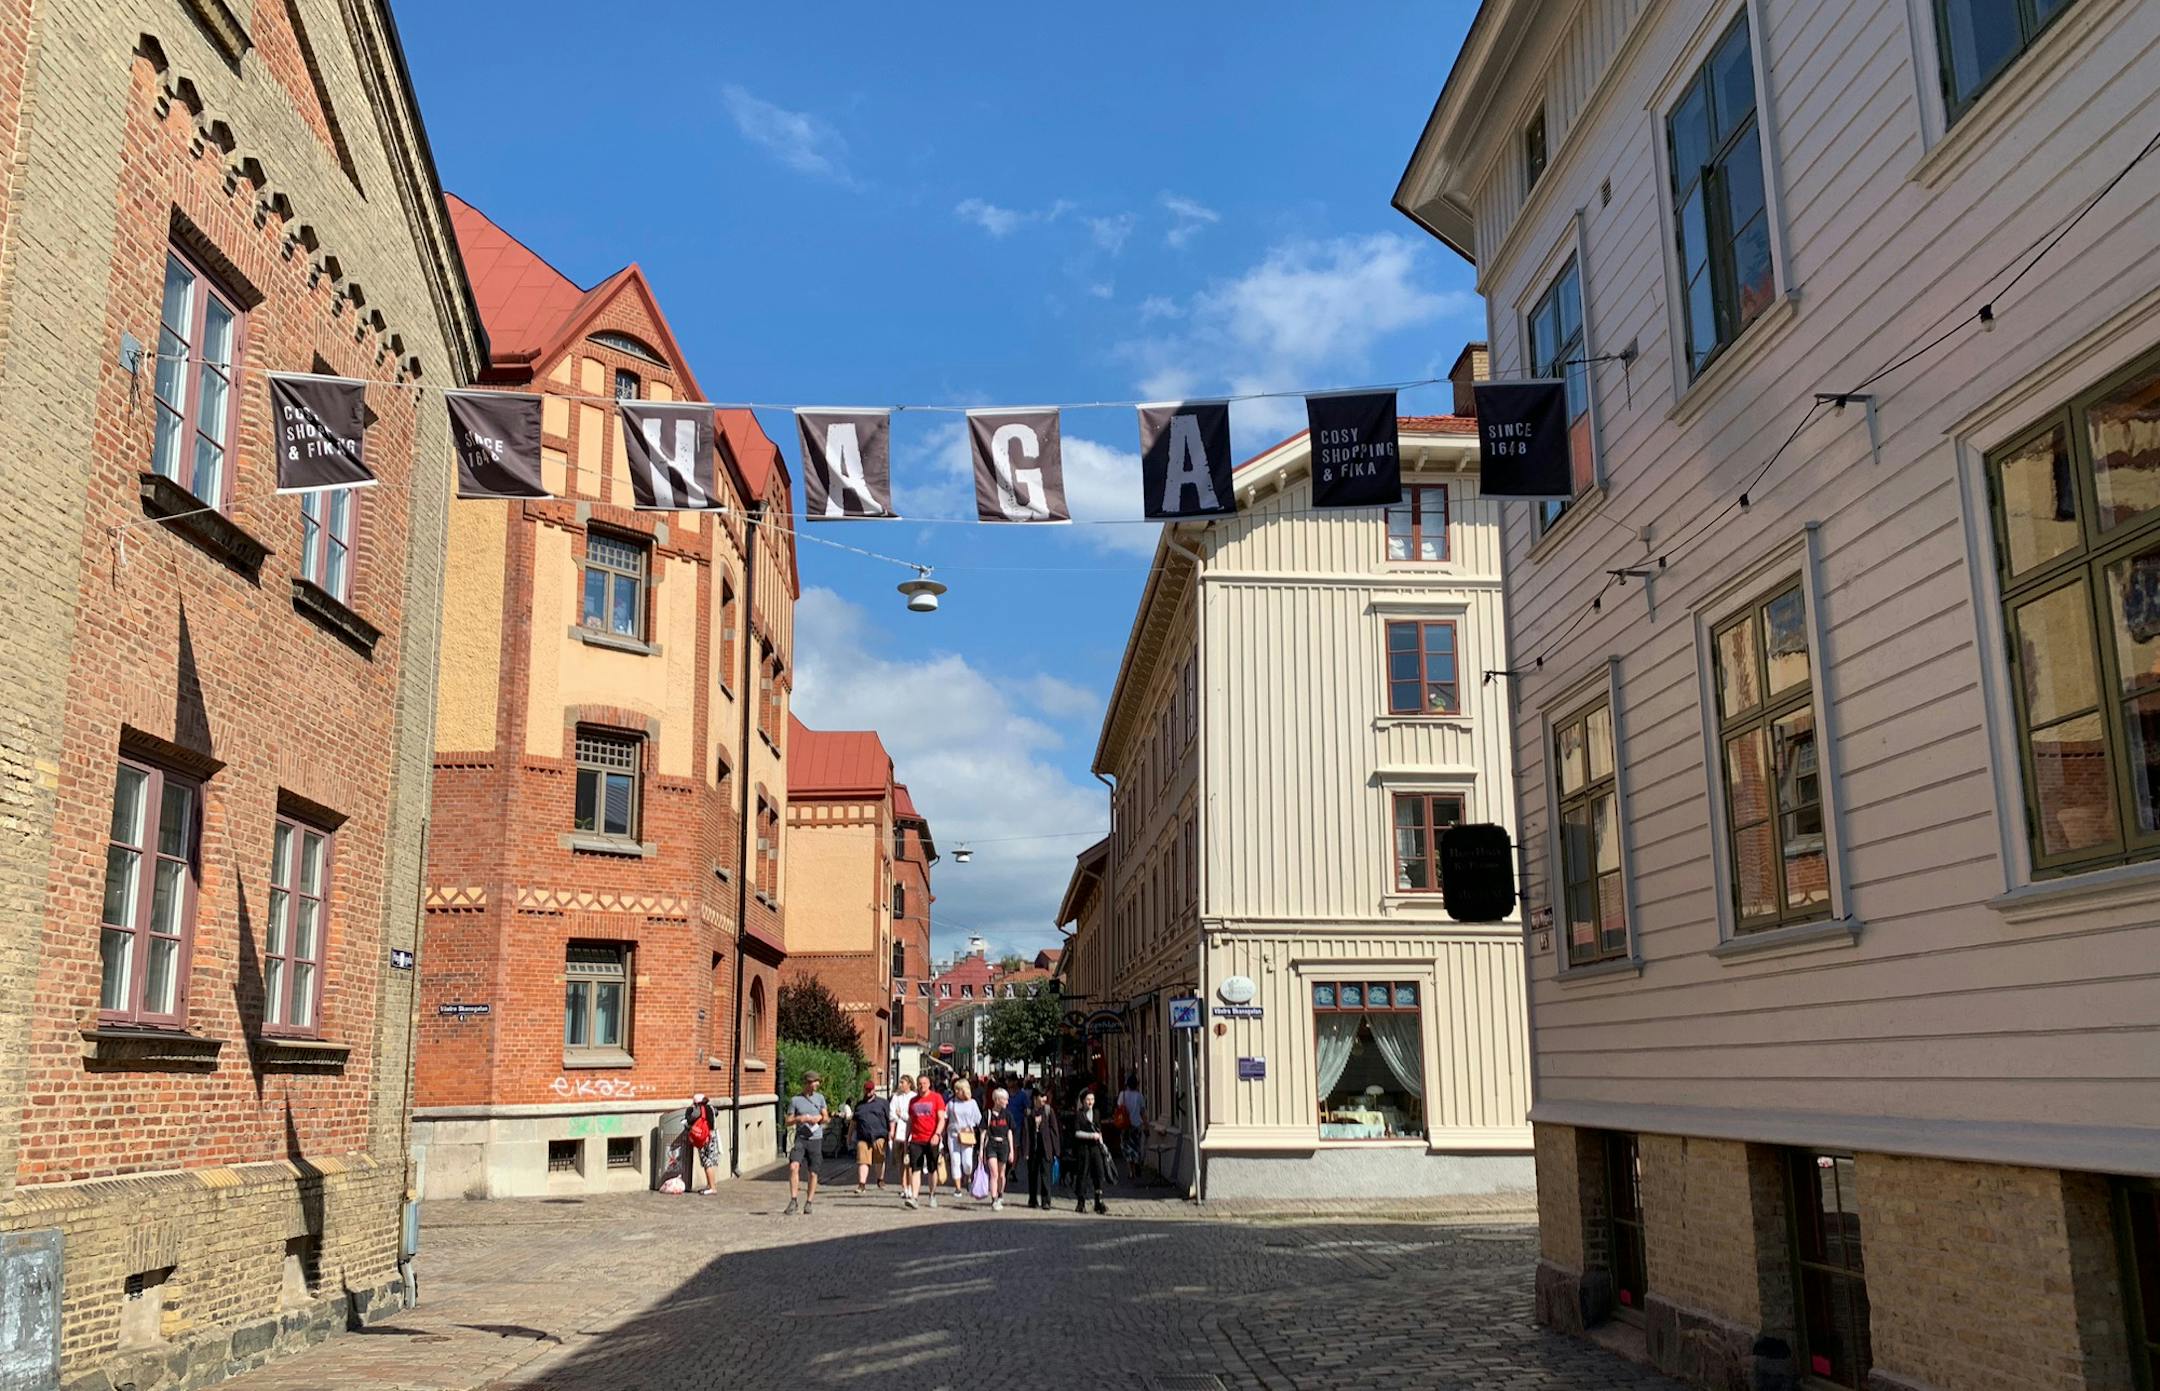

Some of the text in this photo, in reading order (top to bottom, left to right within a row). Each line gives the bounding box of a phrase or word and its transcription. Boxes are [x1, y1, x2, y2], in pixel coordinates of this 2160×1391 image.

[283, 405, 319, 421] COS
[1320, 427, 1359, 445] COSY
[1488, 422, 1533, 438] SINCE
[288, 445, 299, 460] &
[464, 430, 504, 454] SINCE
[1322, 441, 1394, 464] SHOPPING
[1490, 441, 1527, 456] 1648
[642, 418, 708, 507] H
[822, 421, 883, 517] A
[992, 423, 1050, 522] G
[1161, 412, 1221, 513] A
[1323, 461, 1377, 482] & FIKA
